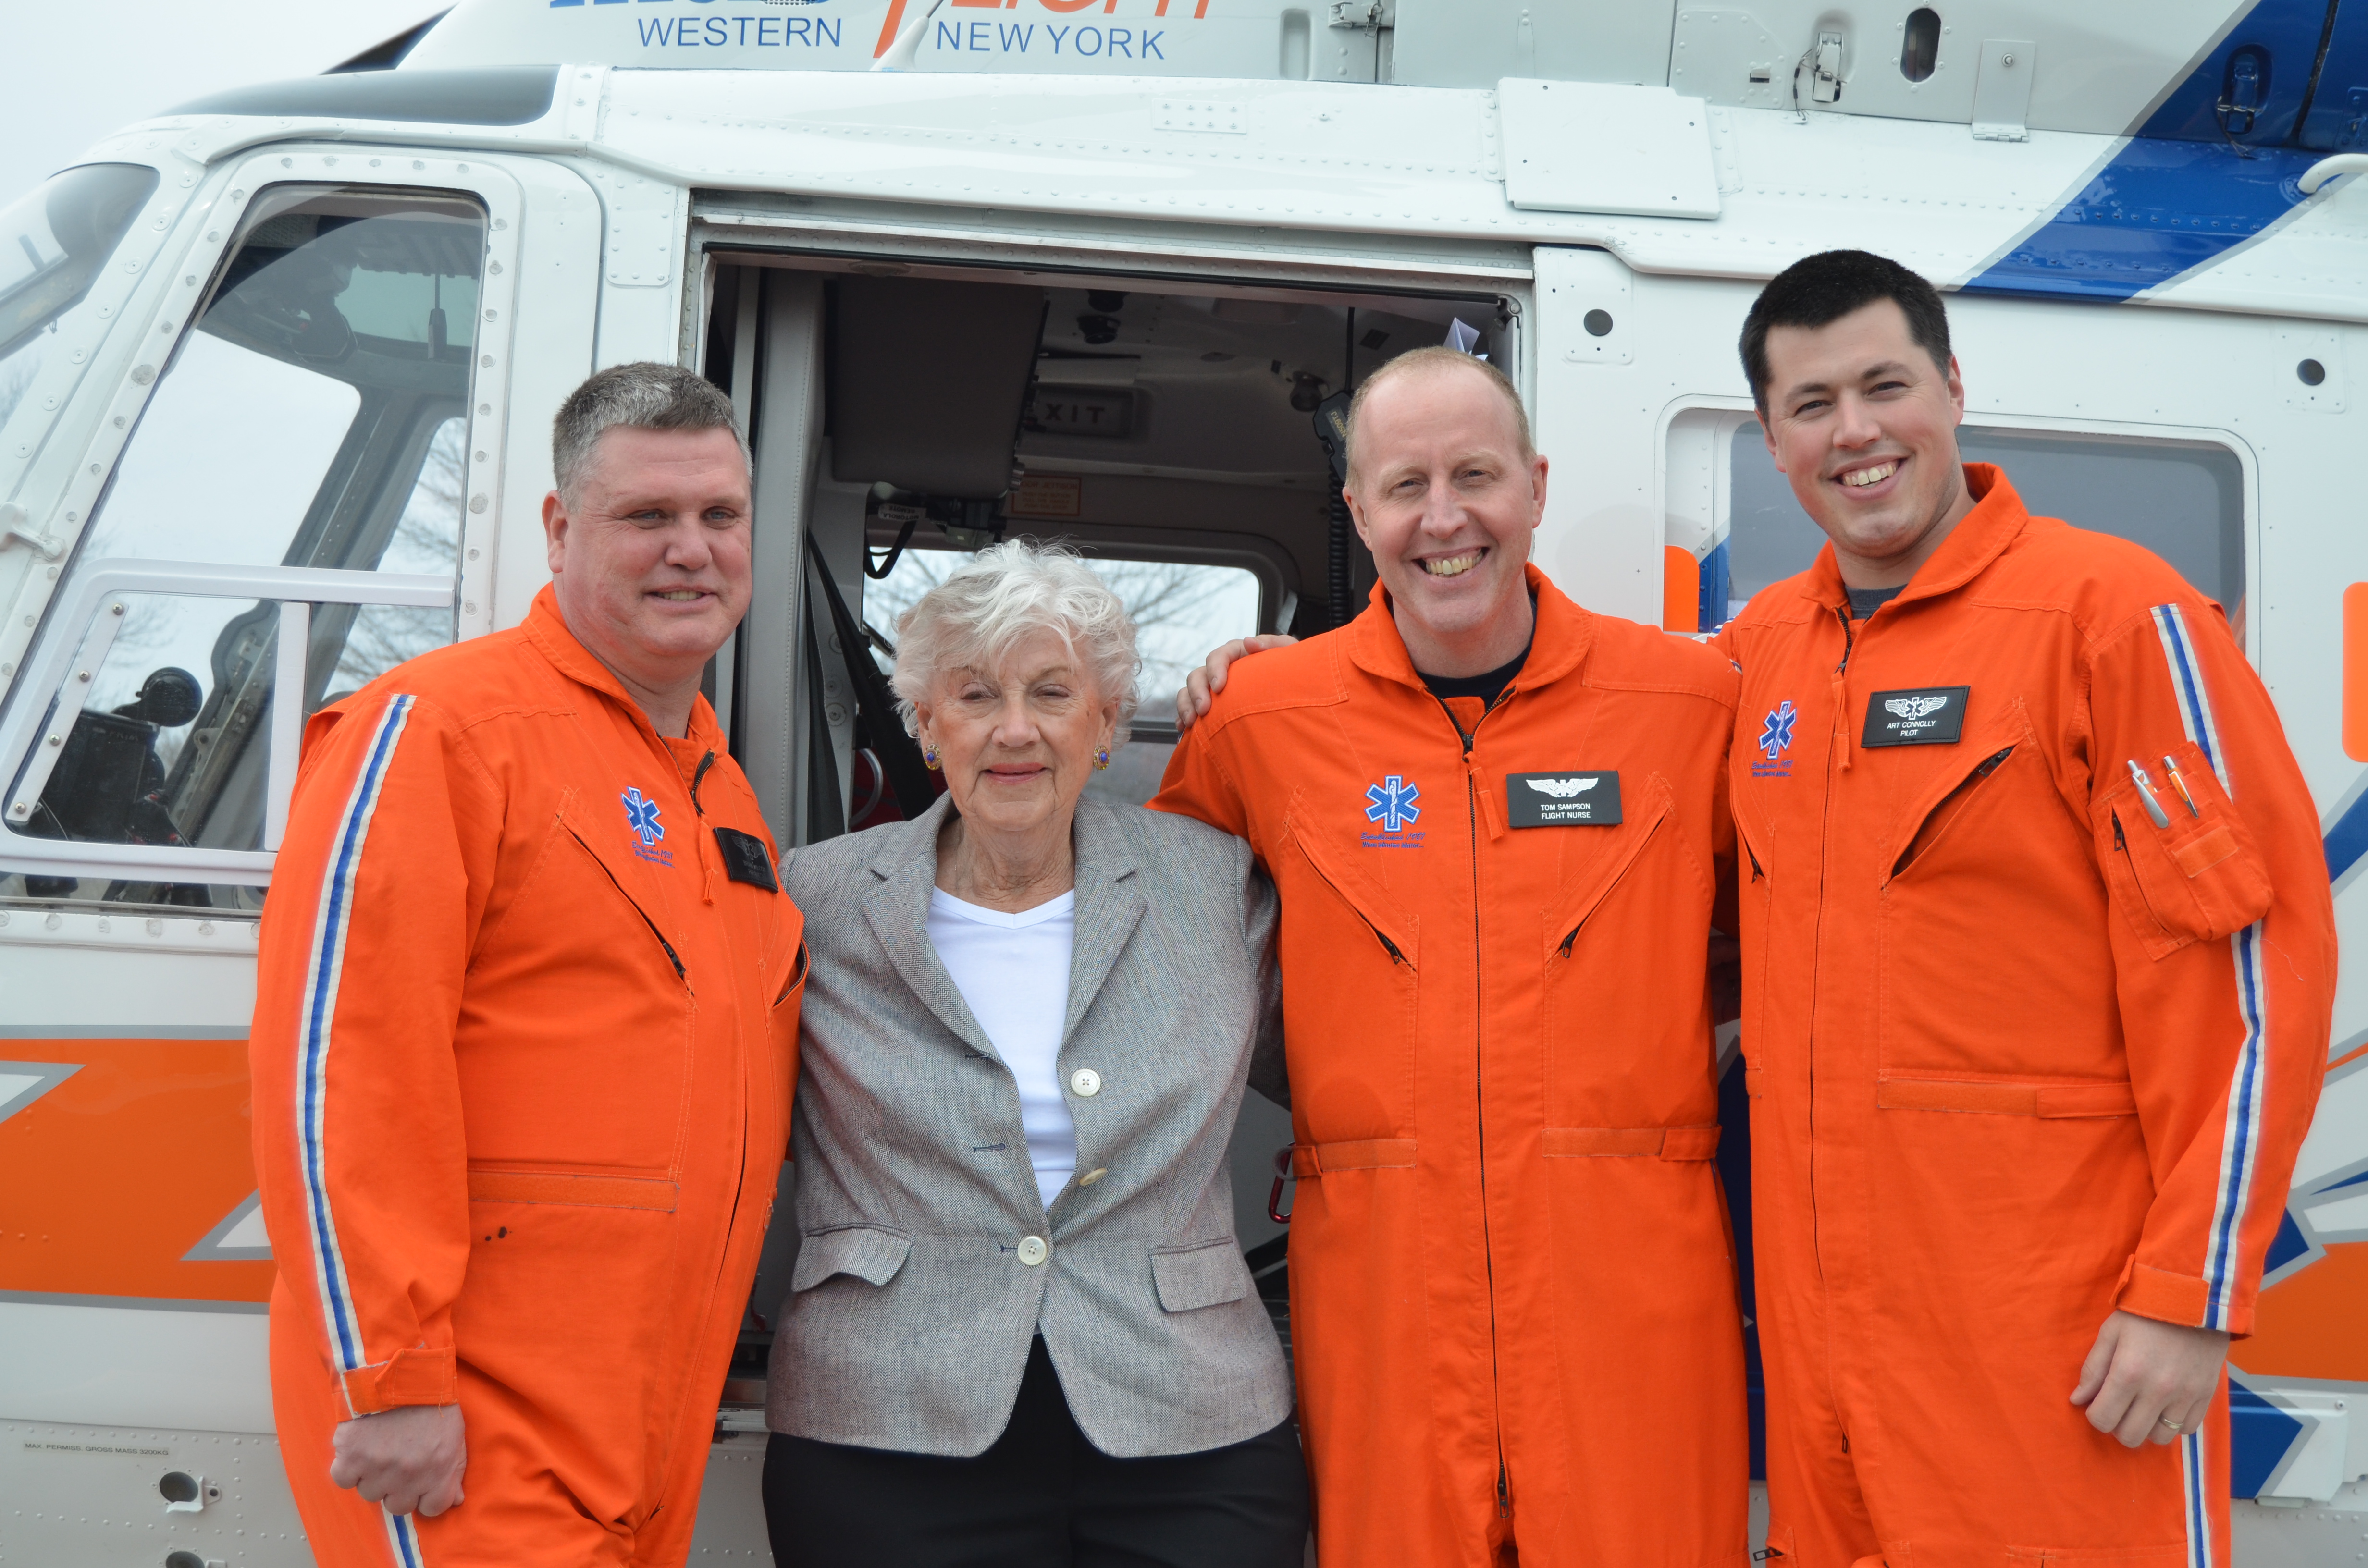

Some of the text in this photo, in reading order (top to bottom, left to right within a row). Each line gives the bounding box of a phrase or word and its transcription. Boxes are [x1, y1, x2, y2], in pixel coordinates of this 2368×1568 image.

[638, 17, 1165, 60] WESTERN NEW YORK
[1043, 403, 1105, 424] XIT
[1902, 720, 1936, 728] CONNOLLY
